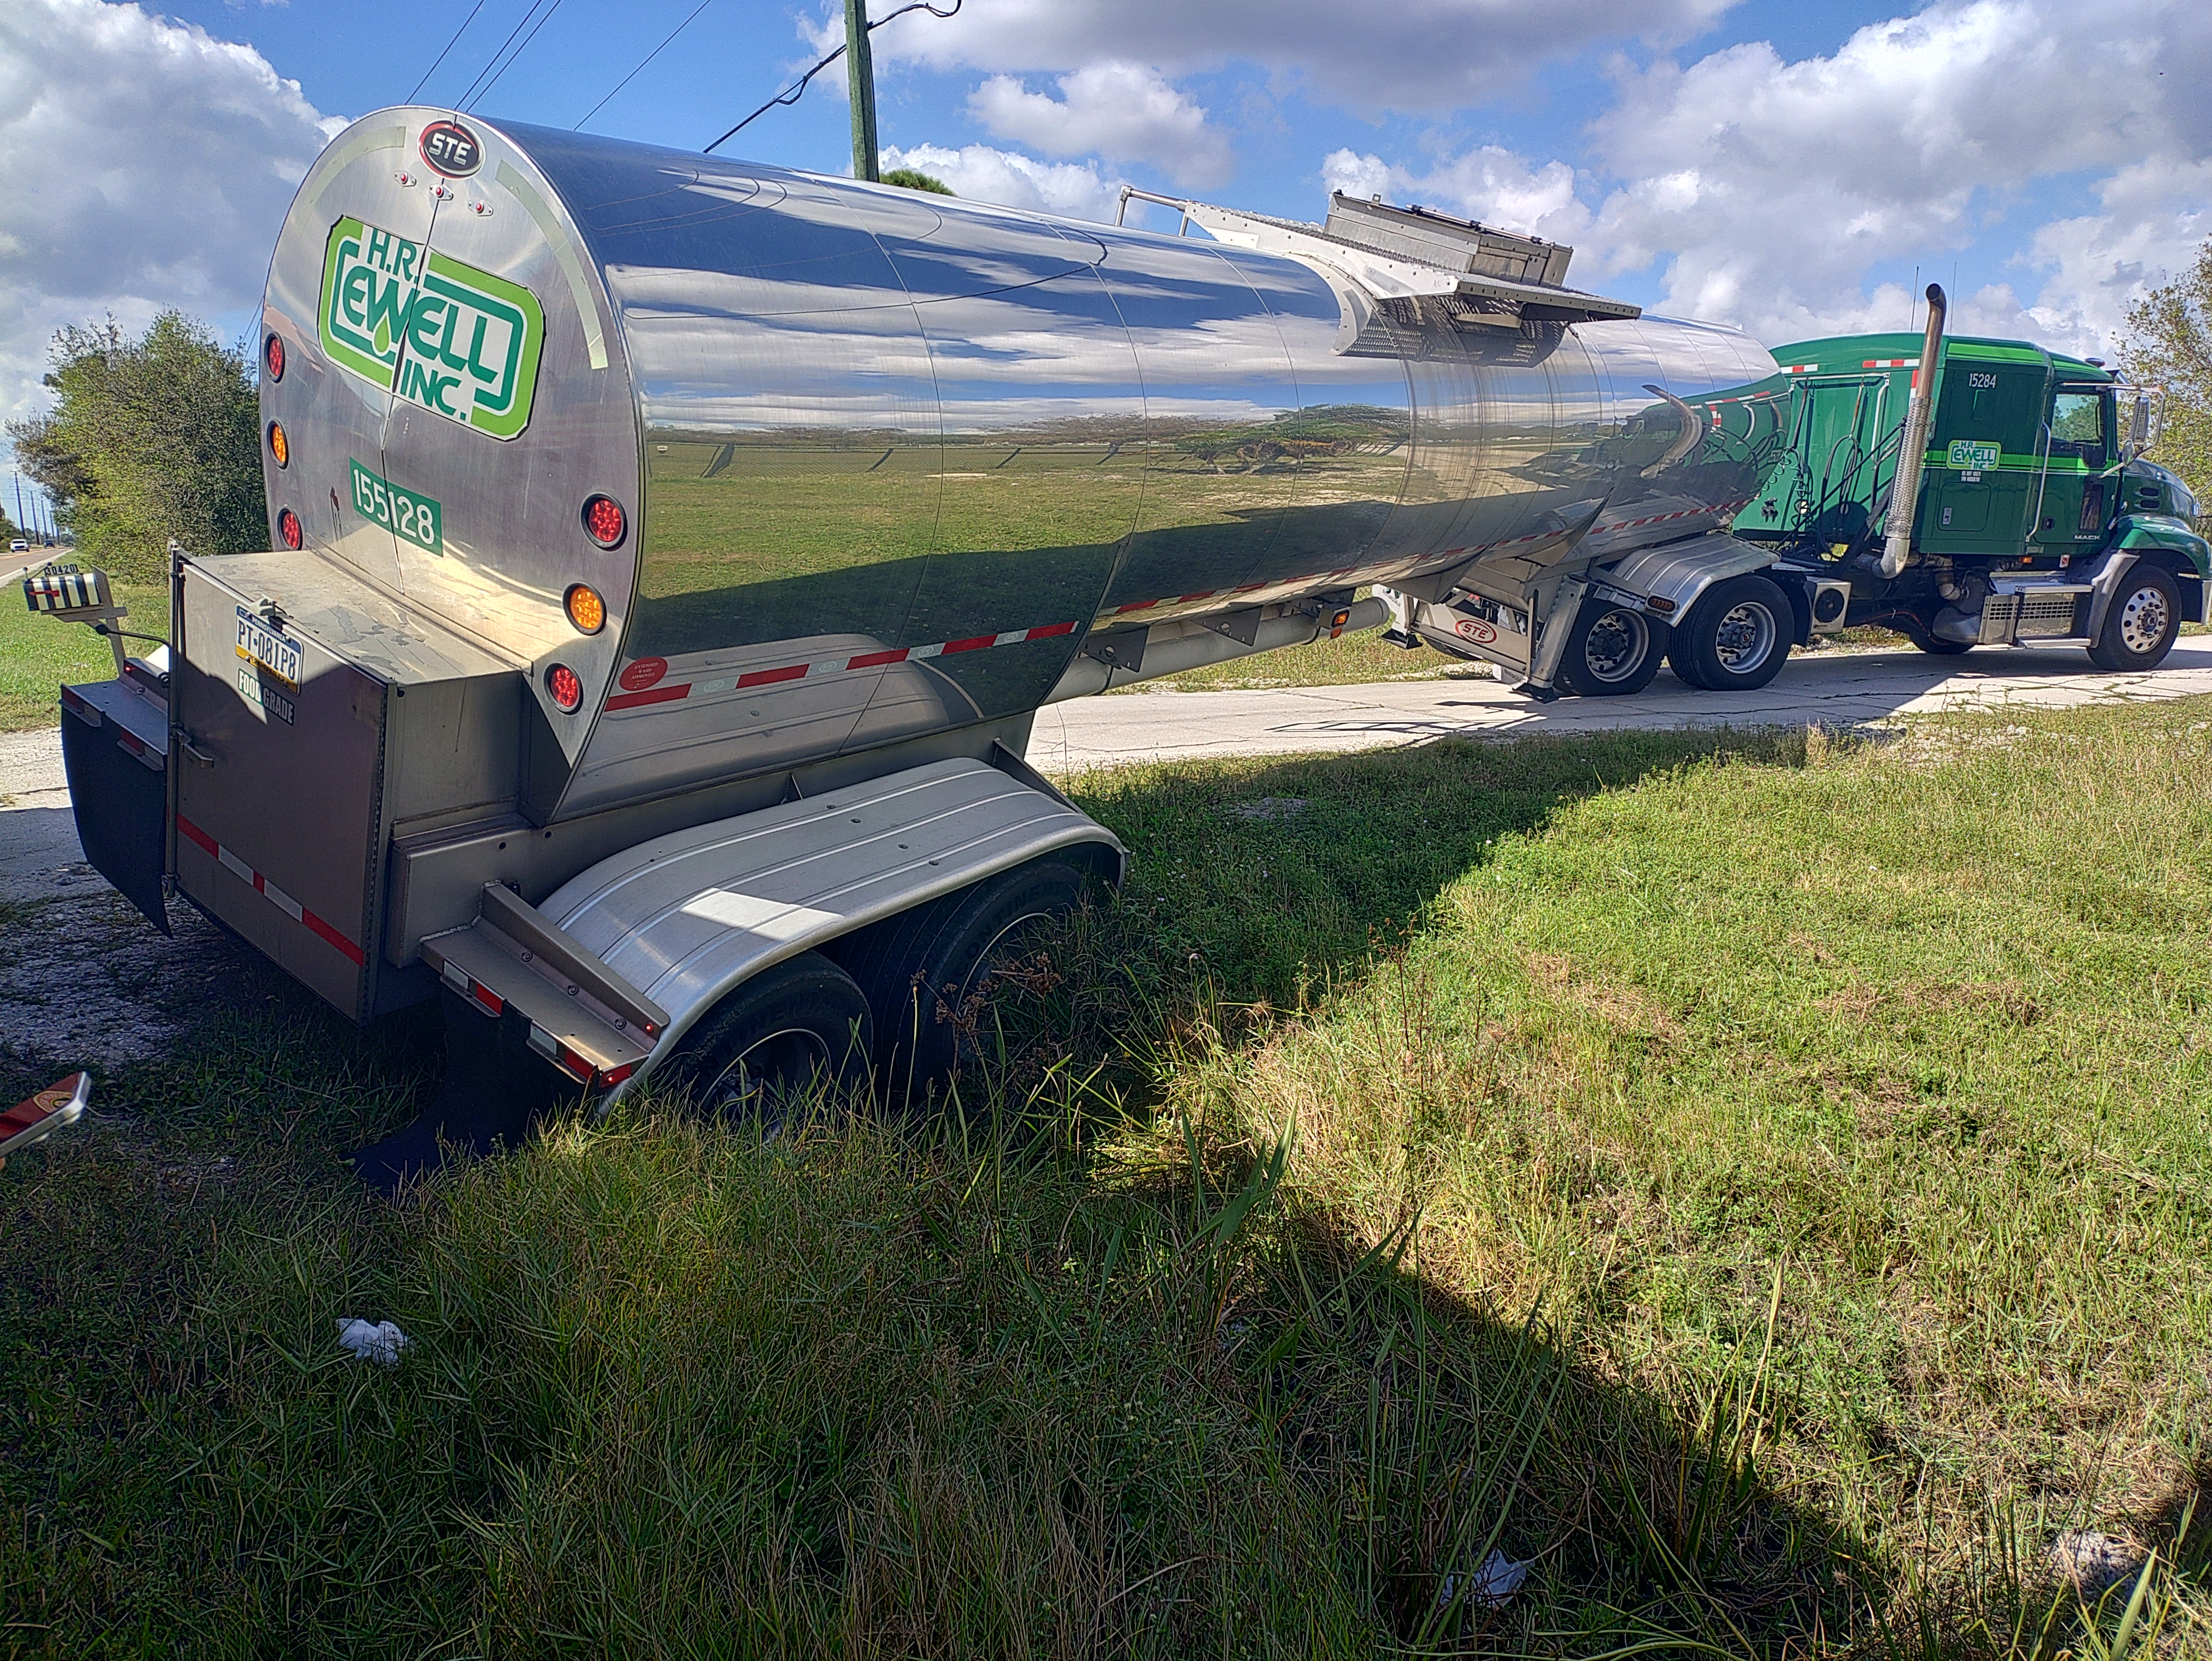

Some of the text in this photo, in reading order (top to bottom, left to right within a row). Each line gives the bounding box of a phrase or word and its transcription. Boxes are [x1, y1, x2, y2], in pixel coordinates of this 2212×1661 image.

[429, 133, 472, 166] STE
[367, 228, 419, 283] H.R.
[343, 266, 498, 384] EWELL
[400, 358, 466, 421] INC.
[1969, 373, 1996, 388] 15284
[1954, 449, 1993, 462] EWELL
[354, 469, 434, 544] 155128
[45, 564, 75, 575] 30420
[252, 617, 286, 642] PENNSYLVANIA
[1462, 623, 1489, 639] STE
[239, 670, 262, 702] FOOD
[264, 687, 293, 724] GRADE
